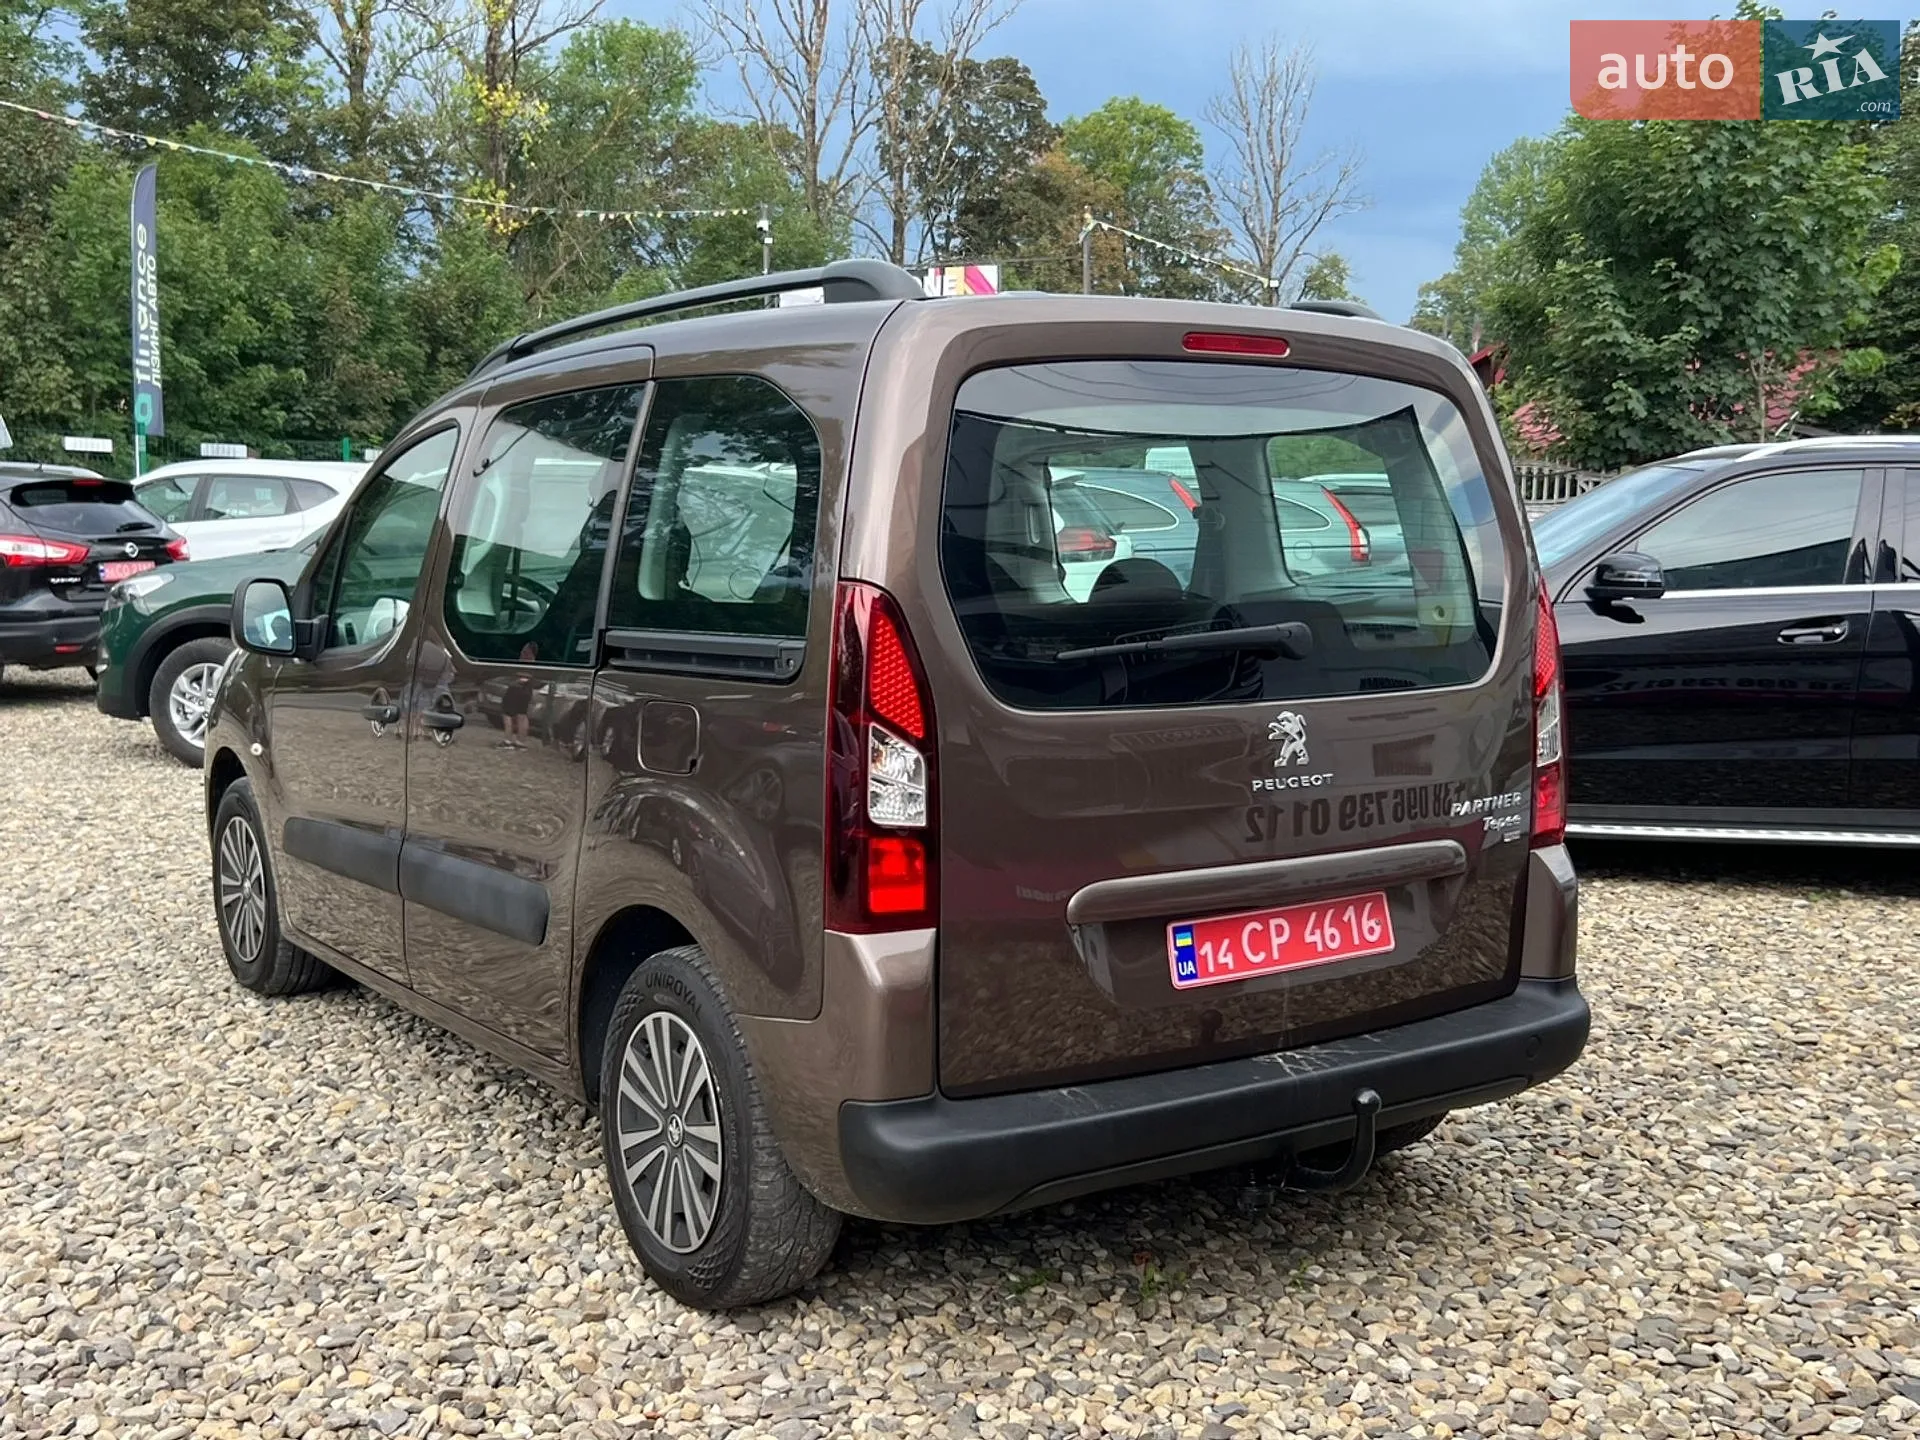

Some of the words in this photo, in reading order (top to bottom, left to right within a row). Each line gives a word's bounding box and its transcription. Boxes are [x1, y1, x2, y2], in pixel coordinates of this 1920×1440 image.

[135, 223, 151, 385] finance
[146, 254, 158, 312] АВТО
[1252, 773, 1334, 792] PEUGEOT
[1450, 791, 1521, 817] PARTNER
[1199, 938, 1235, 974] 14
[1241, 917, 1291, 965] CP
[1303, 901, 1384, 953] 4616
[1178, 960, 1197, 976] UA
[645, 971, 703, 1017] UNIROYAL
